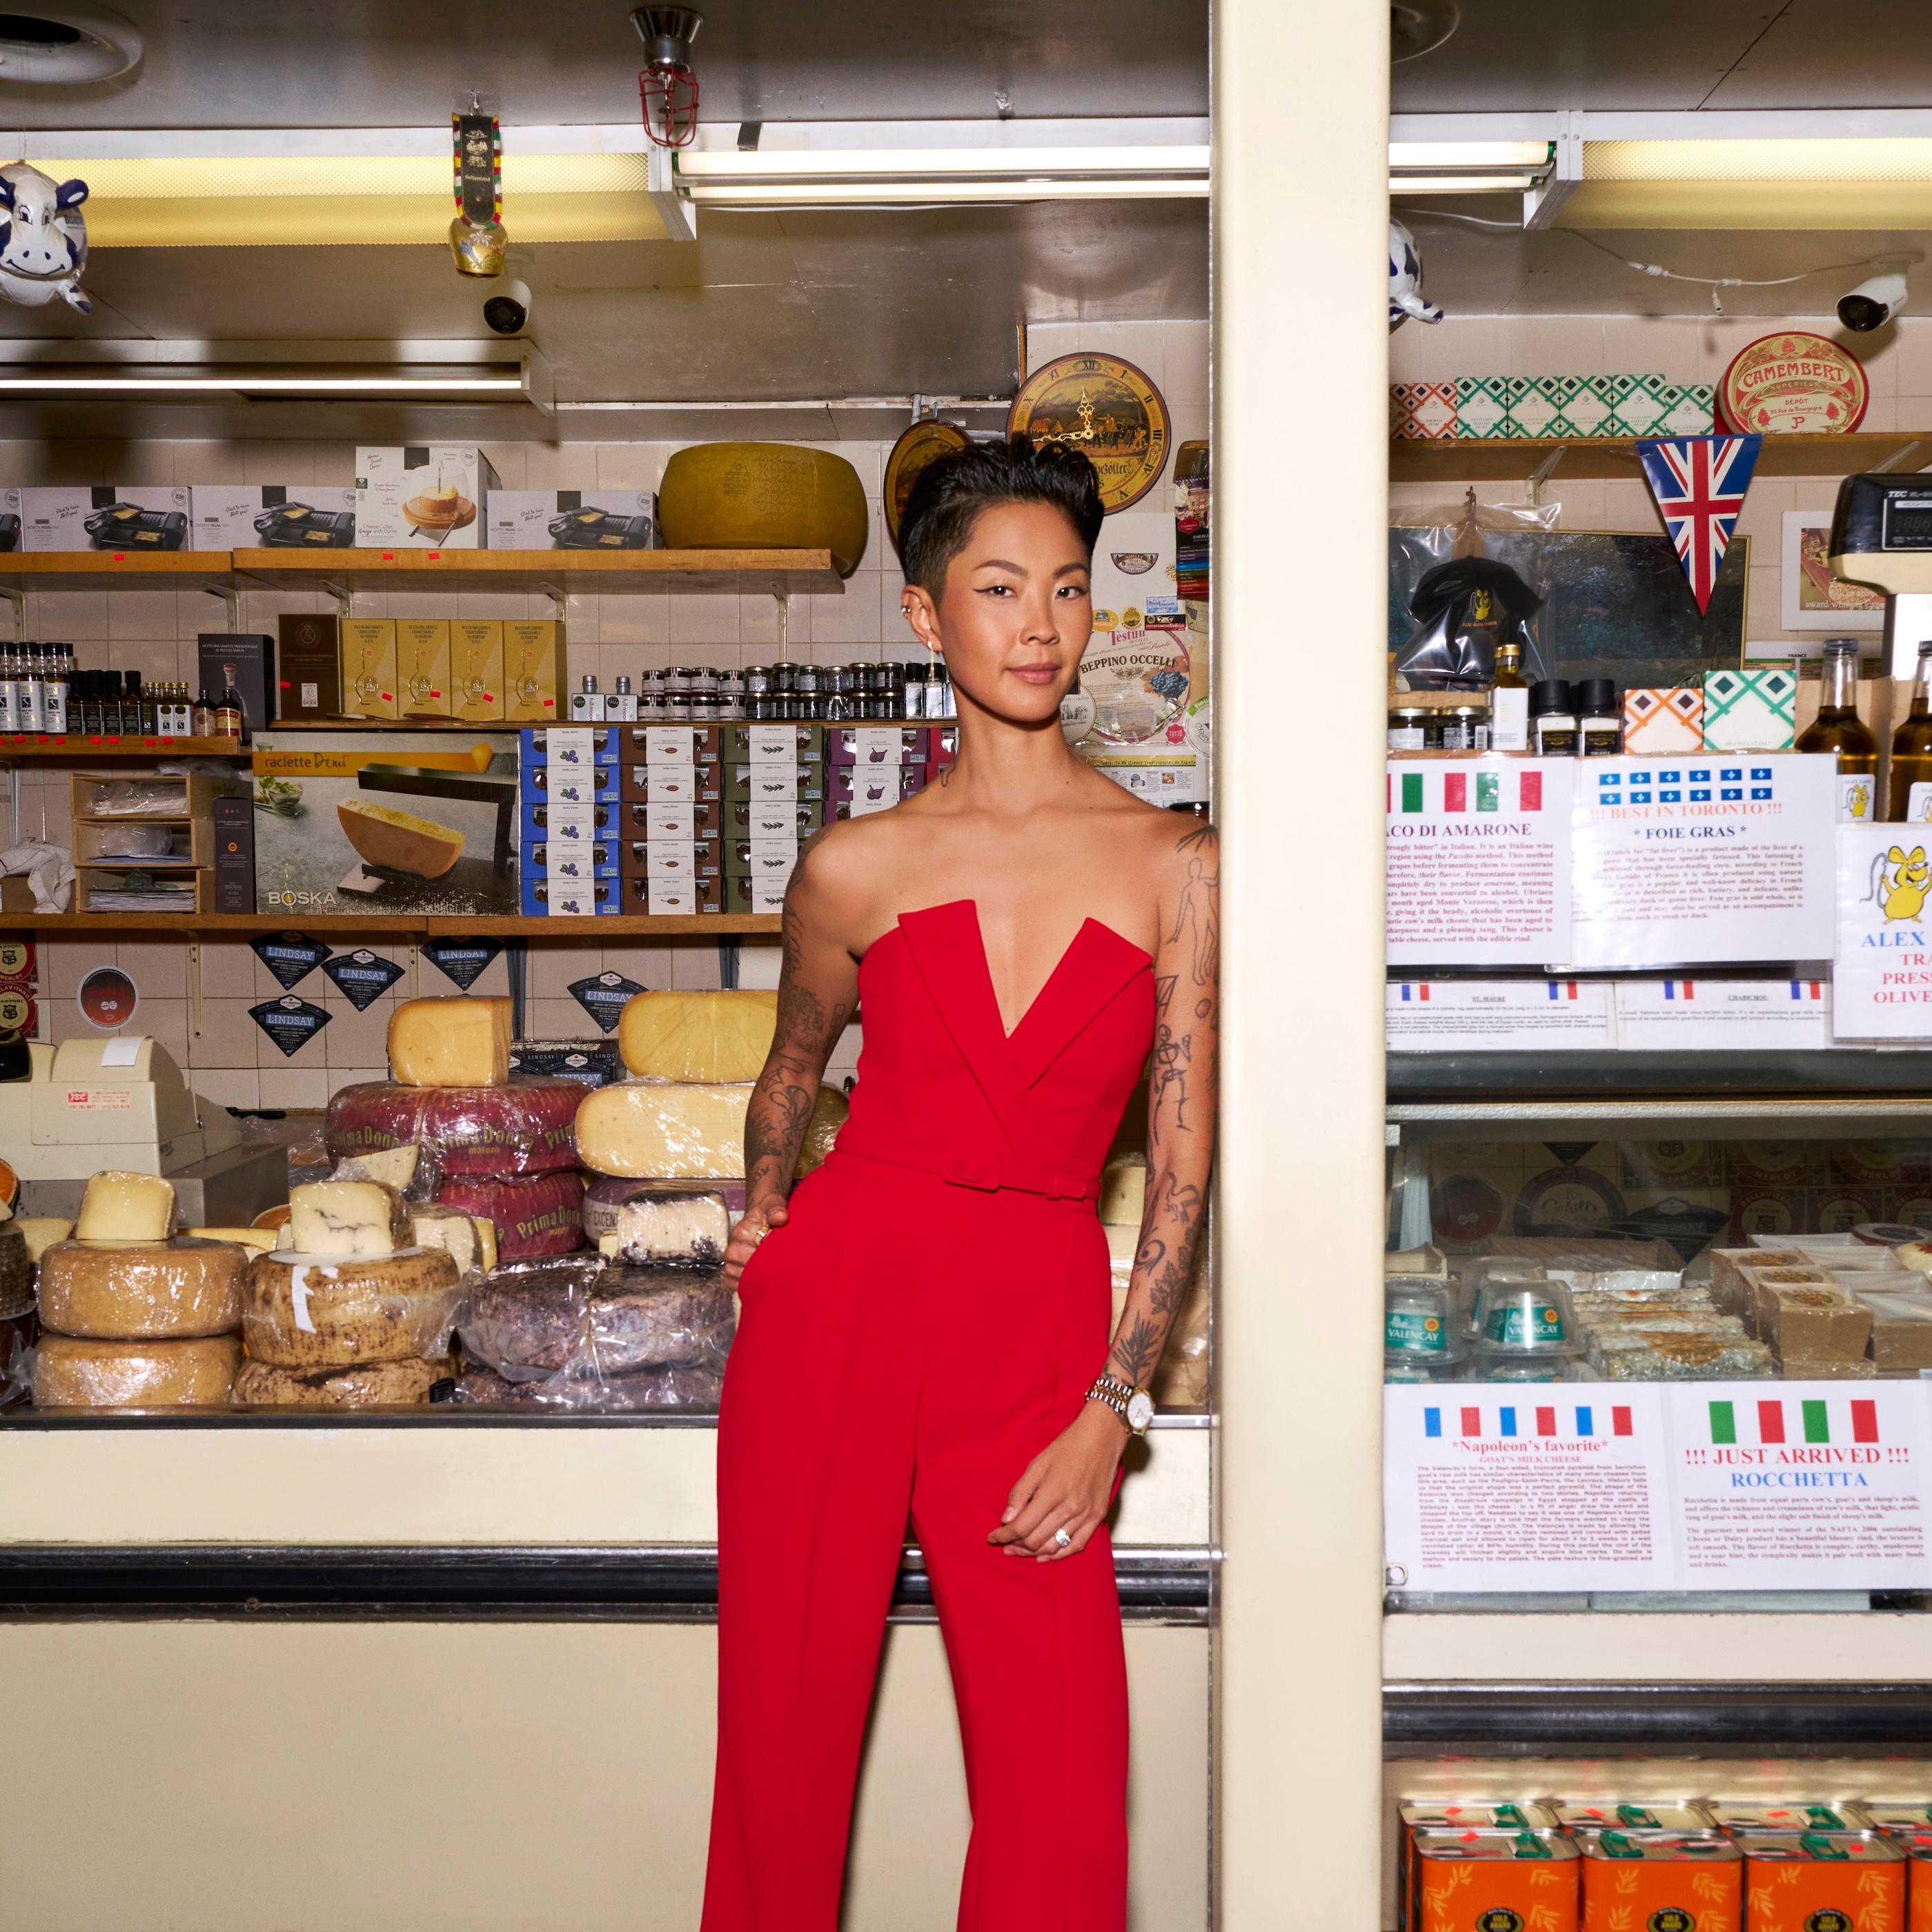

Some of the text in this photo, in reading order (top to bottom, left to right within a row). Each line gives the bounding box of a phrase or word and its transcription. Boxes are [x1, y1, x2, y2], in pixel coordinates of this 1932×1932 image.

[1742, 362, 1844, 388] CAMEMBERT
[1079, 655, 1176, 674] BEPPINO OCCELLI
[264, 756, 311, 768] raclette
[1610, 806, 1652, 820] BEST
[1657, 805, 1674, 818] IN
[1679, 803, 1763, 817] TORONTO
[1419, 825, 1437, 837] DI
[1441, 823, 1532, 836] AMARONE
[1646, 825, 1736, 839] FOIE GRAS
[268, 890, 337, 907] BOSKA
[1861, 931, 1926, 947] ALEX
[268, 947, 314, 960] LINDSAY
[439, 949, 487, 959] LINDSAY
[340, 969, 386, 981] LINDSAY
[1882, 972, 1932, 985] PRES
[0, 985, 30, 999] LAVITANO
[586, 990, 633, 1002] LINDSAY
[268, 1015, 313, 1027] LINDSAY
[545, 1123, 575, 1149] Prim
[468, 1145, 501, 1155] maturo
[516, 1205, 582, 1240] Prima Donn
[1388, 1328, 1439, 1341] VALENCAY
[1545, 1455, 1582, 1463] CHEESE
[1713, 1449, 1768, 1465] JUST
[1775, 1448, 1881, 1464] ARRIVED
[1731, 1472, 1869, 1488] ROCCHETTA
